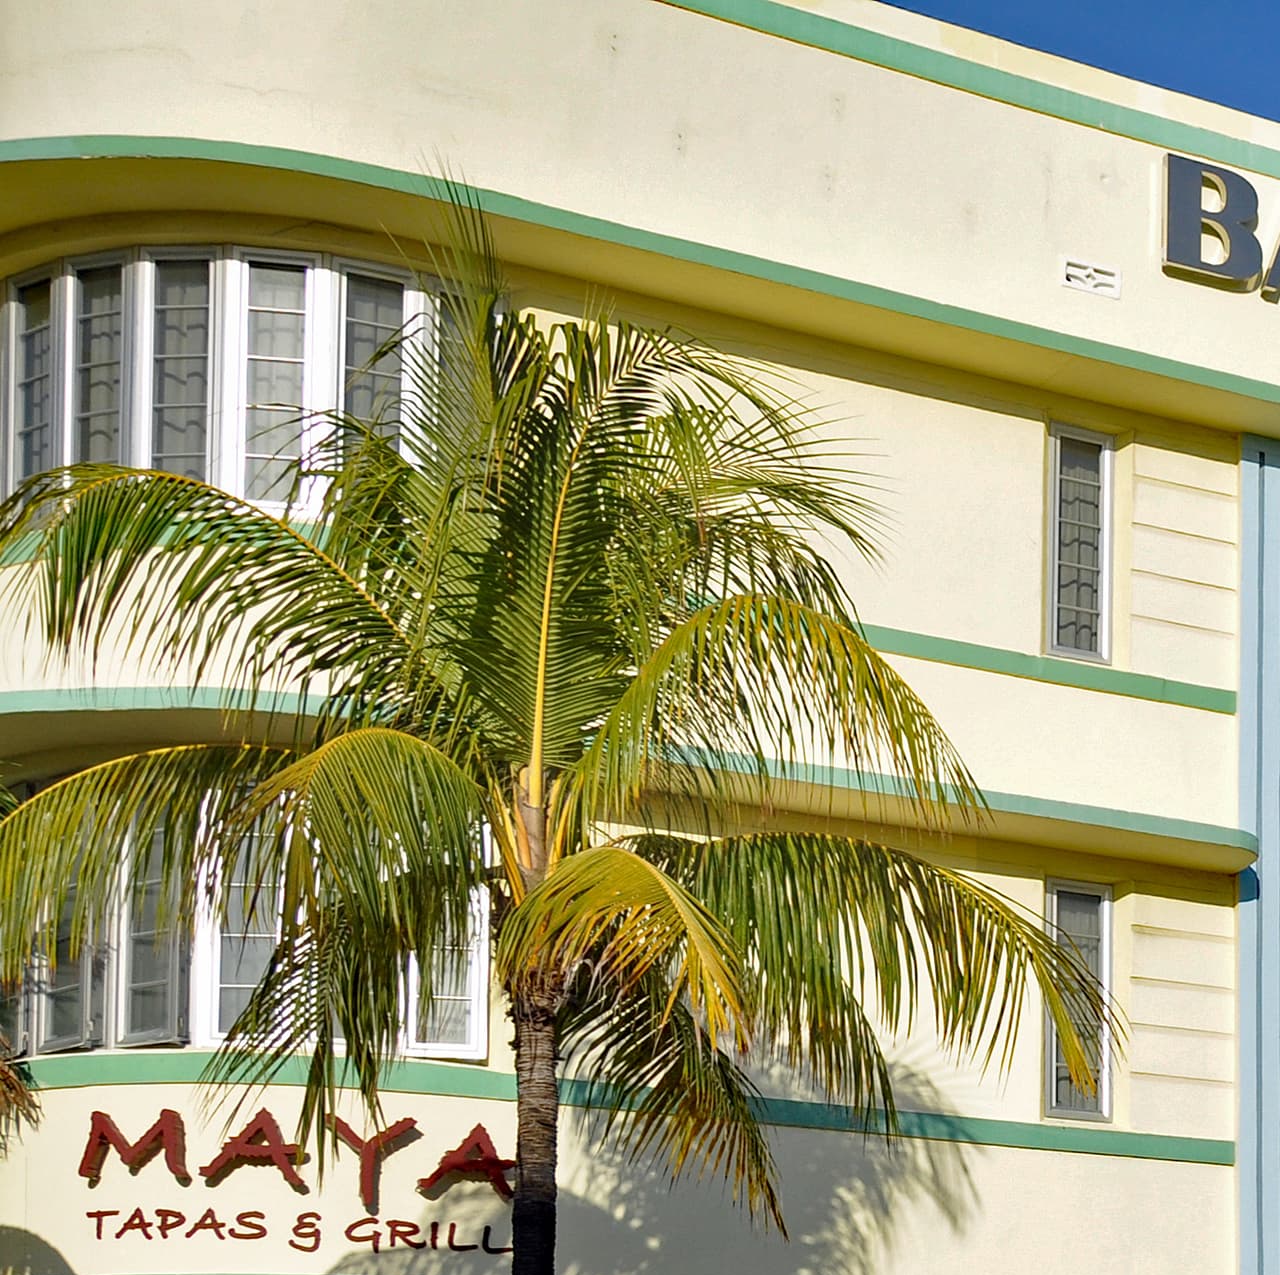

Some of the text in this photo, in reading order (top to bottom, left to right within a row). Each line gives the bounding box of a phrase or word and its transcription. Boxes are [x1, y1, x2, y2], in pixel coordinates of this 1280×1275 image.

[78, 1108, 517, 1208] MAYA
[86, 1208, 514, 1254] TAPAS & GRILL
